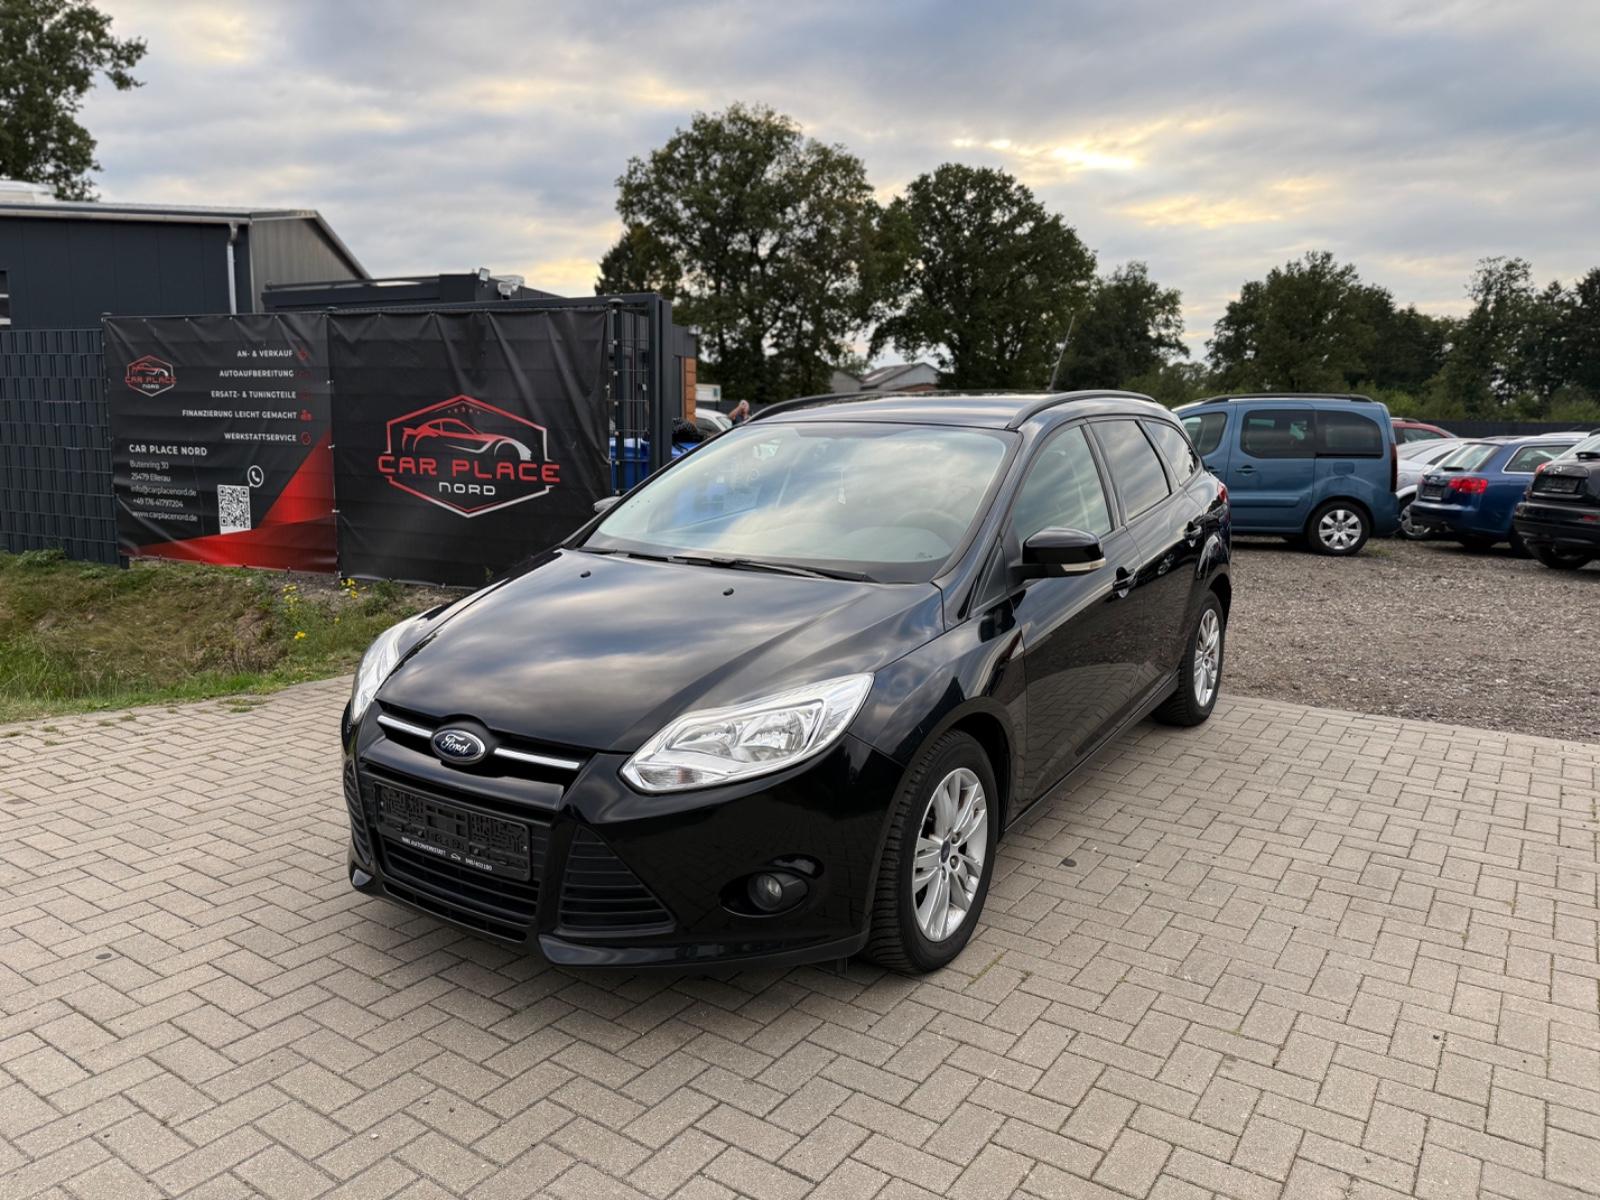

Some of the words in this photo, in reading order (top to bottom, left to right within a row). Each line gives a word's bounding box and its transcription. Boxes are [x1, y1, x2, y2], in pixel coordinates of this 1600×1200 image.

[219, 369, 294, 377] AUTOAUFBEREITUNG
[211, 390, 240, 398] ERSATZ-
[249, 391, 296, 399] TUNINGTEILE
[182, 409, 233, 417] FINANZIERUNG
[234, 410, 260, 418] LEICHT
[262, 411, 297, 419] GEMACHT
[224, 432, 297, 442] WERKSTATTSERVICE
[129, 444, 147, 453] CAR
[149, 445, 178, 455] PLACE
[181, 447, 208, 456] NORD
[378, 455, 437, 476] CAR
[452, 460, 561, 483] PLACE
[438, 481, 496, 496] NORD
[441, 734, 470, 755] Ford
